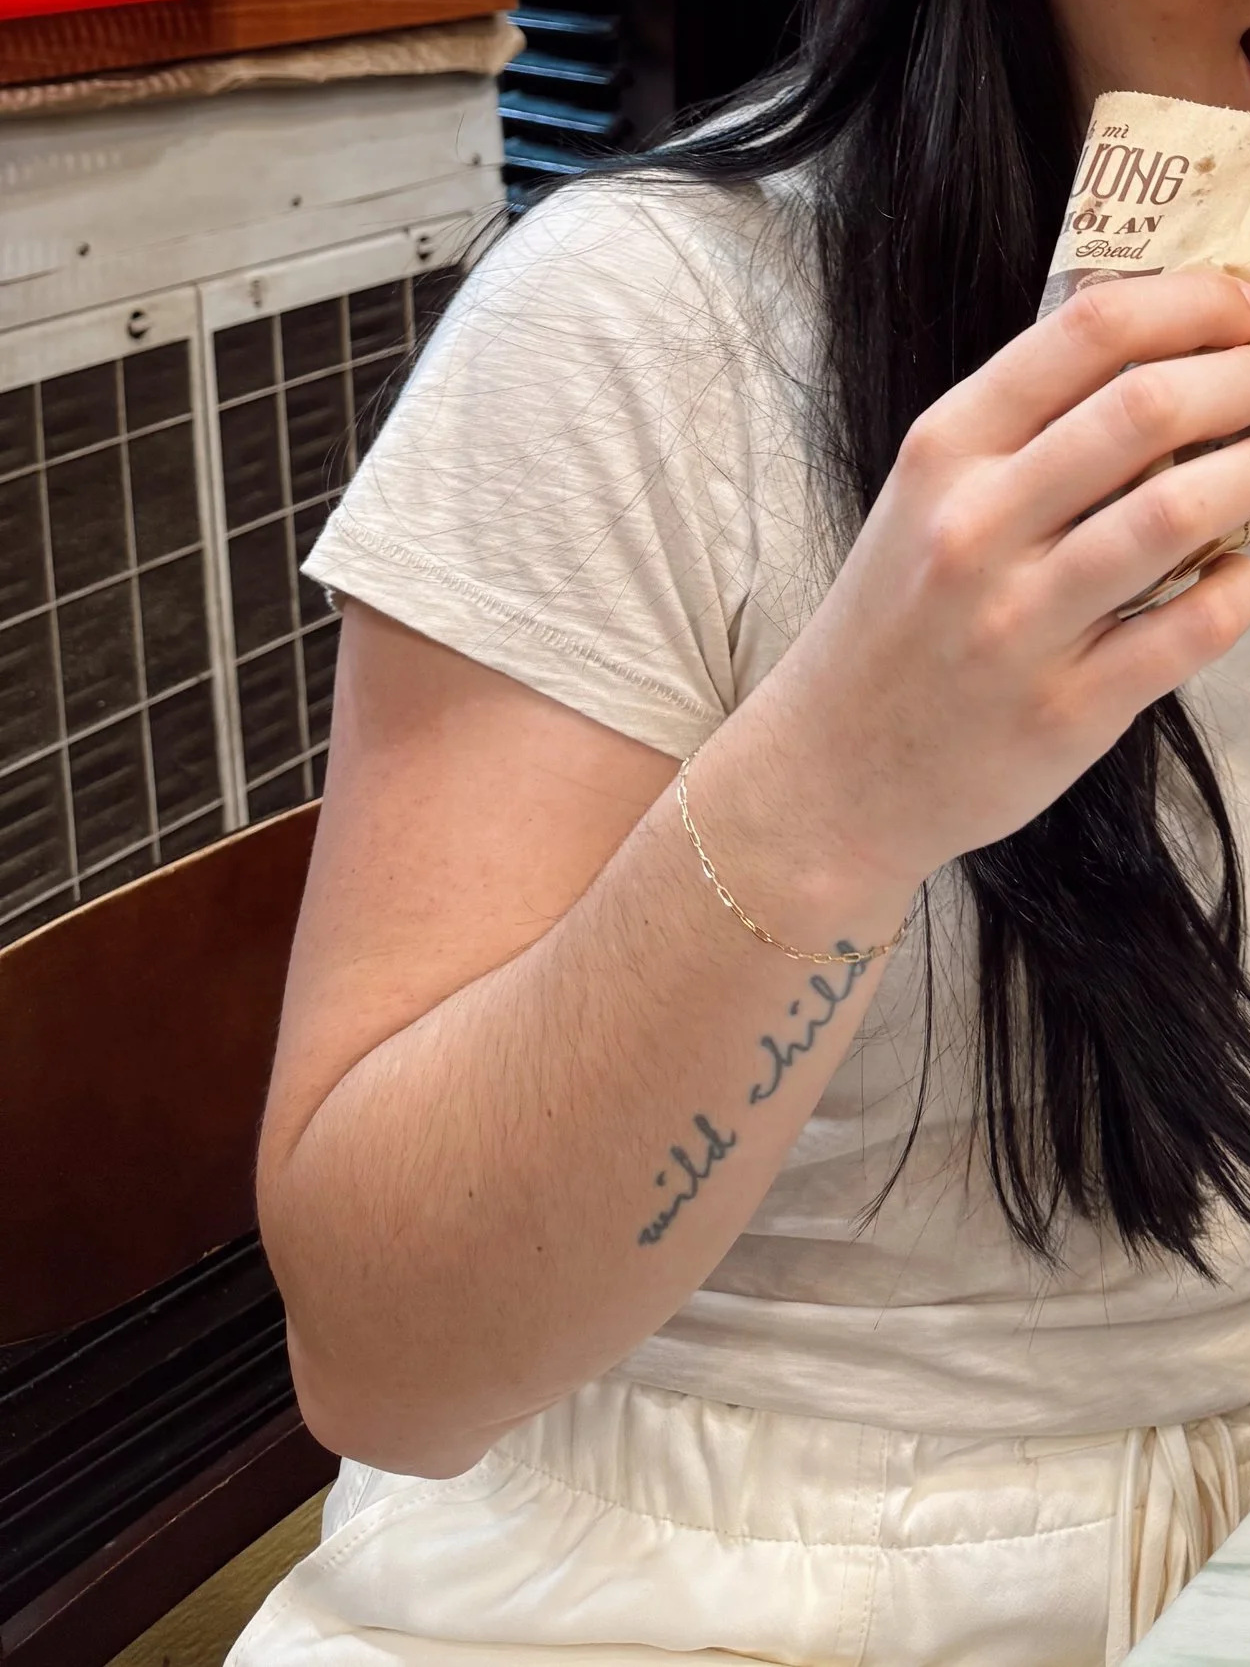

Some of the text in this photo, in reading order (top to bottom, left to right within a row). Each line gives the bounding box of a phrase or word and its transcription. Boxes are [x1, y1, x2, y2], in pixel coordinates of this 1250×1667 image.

[1114, 214, 1164, 235] AN
[1075, 238, 1151, 260] Bread
[638, 939, 873, 1246] wild child
